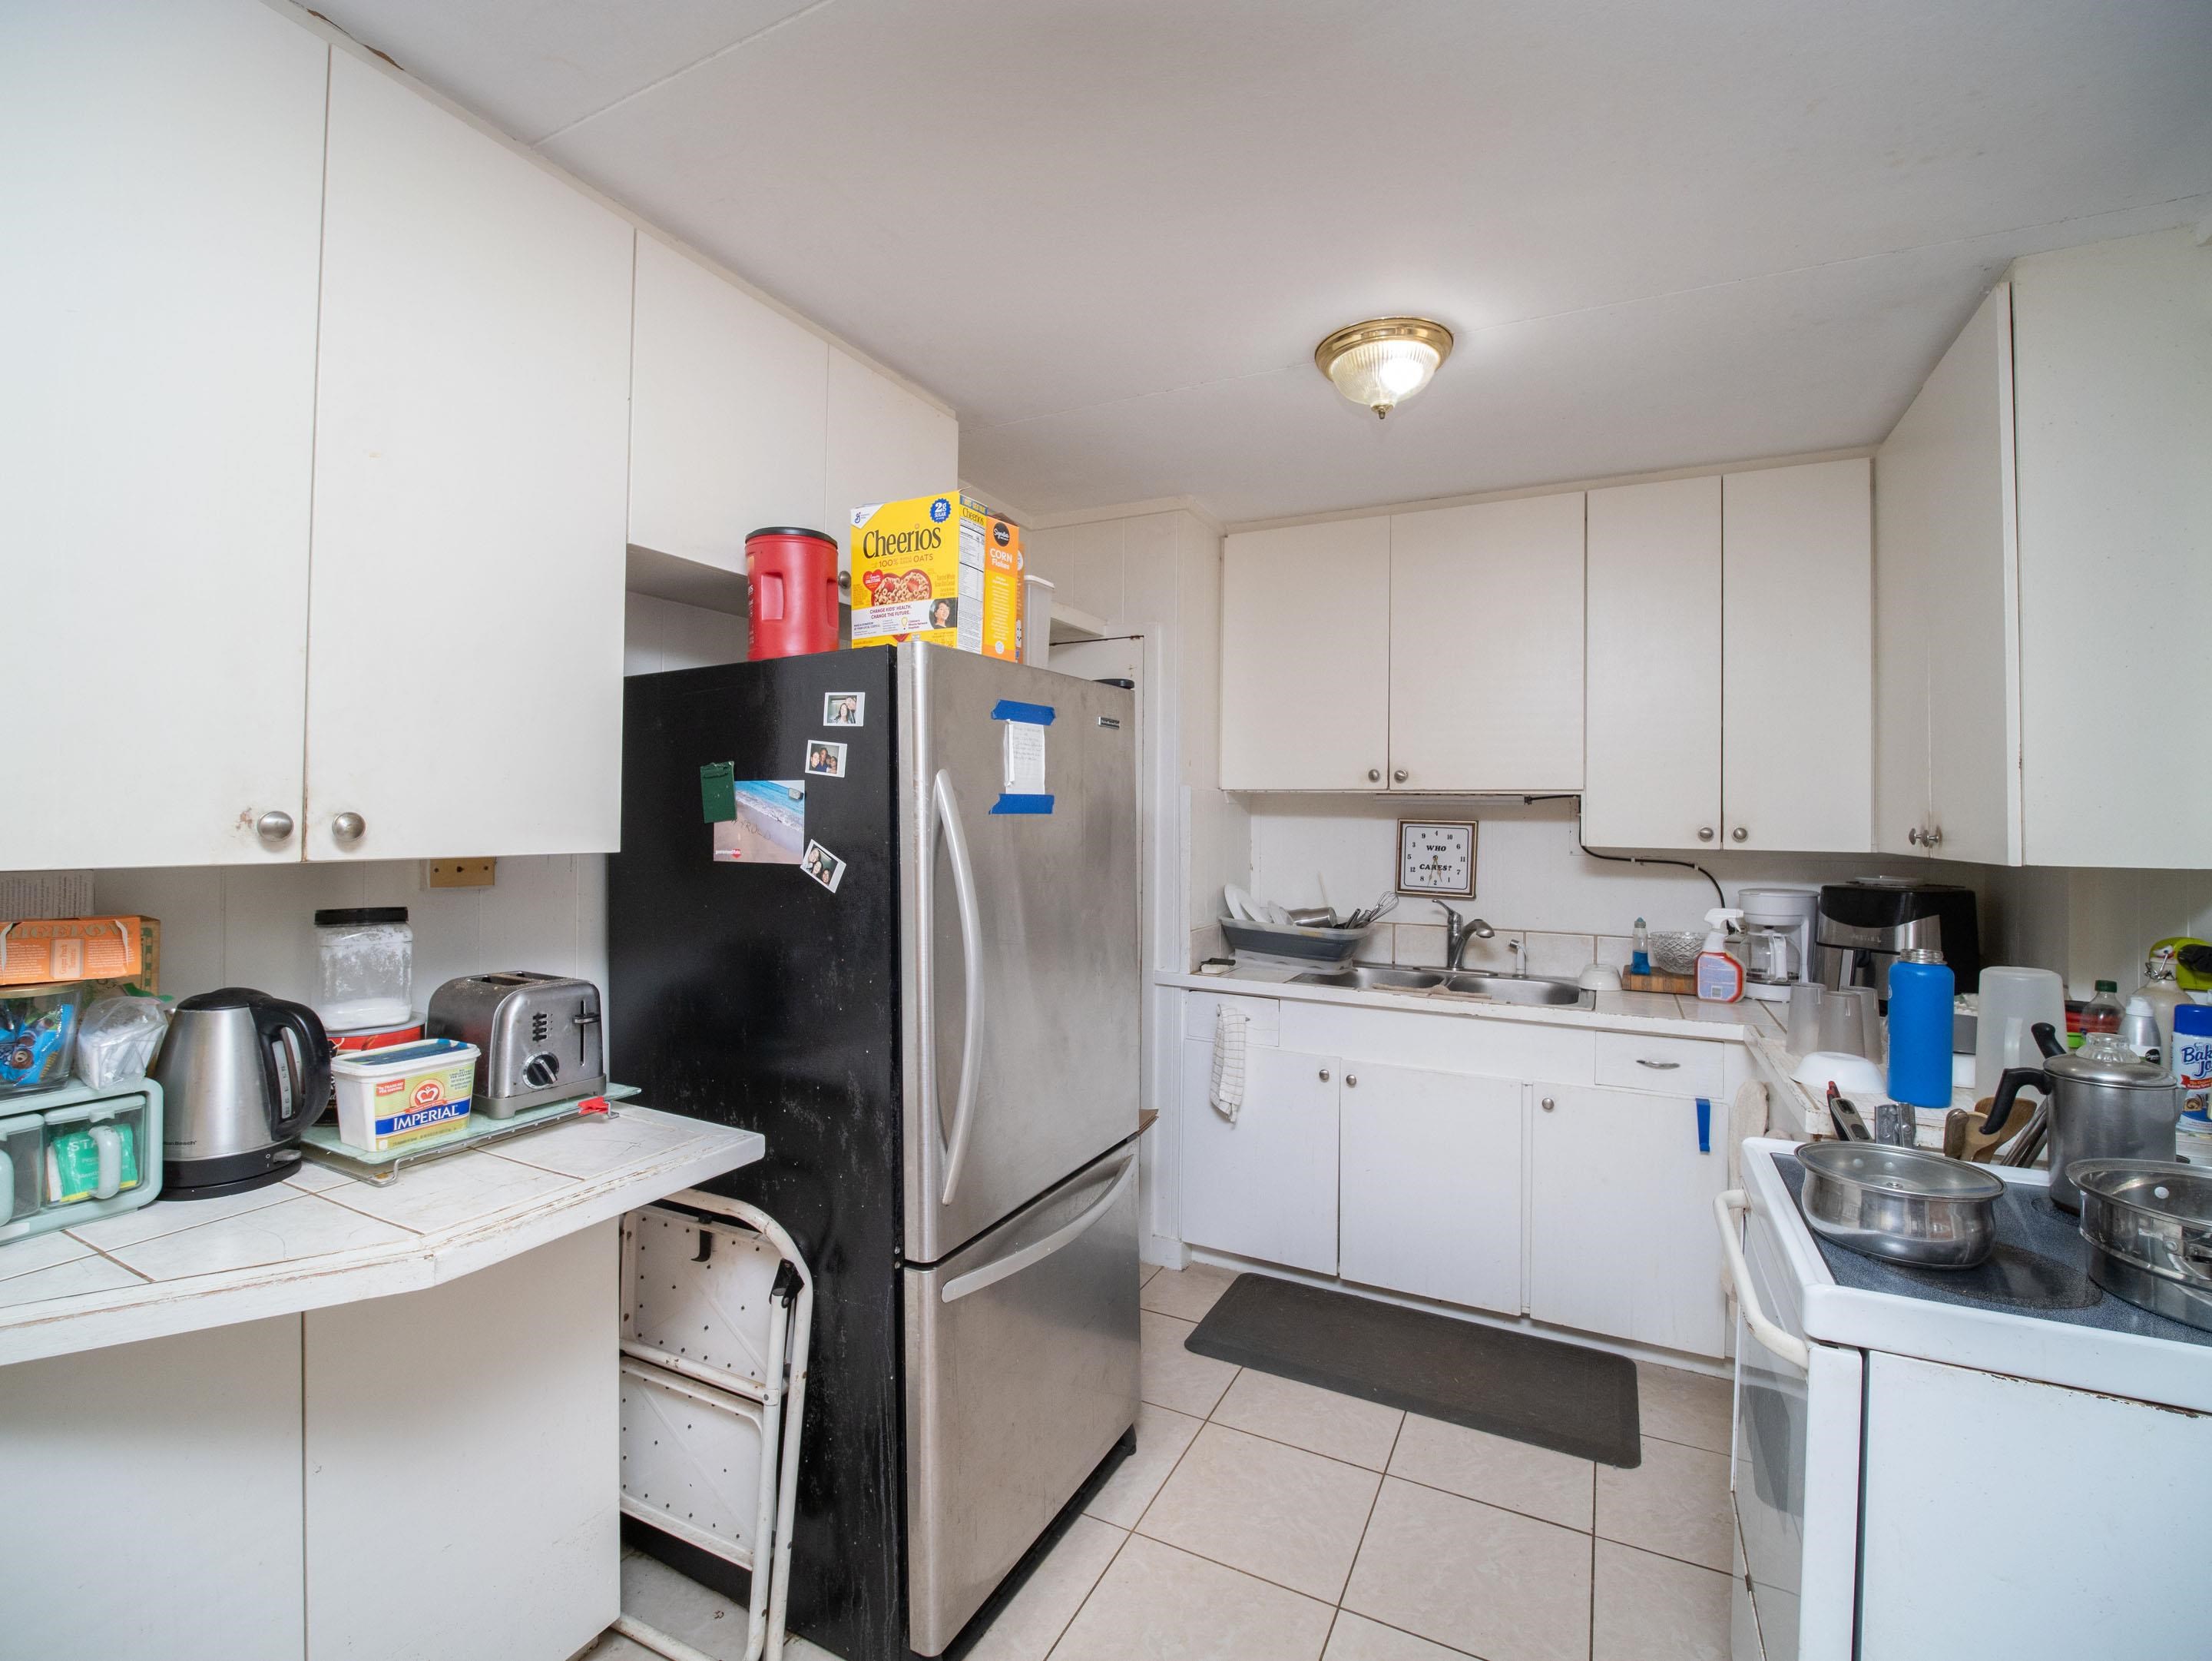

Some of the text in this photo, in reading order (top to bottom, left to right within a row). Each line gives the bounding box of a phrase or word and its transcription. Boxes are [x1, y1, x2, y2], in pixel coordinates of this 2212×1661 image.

[935, 502, 947, 513] 2g
[962, 507, 984, 525] Cheerios
[863, 523, 942, 559] Cheerios
[913, 553, 934, 562] OATS
[989, 548, 1012, 563] CORN
[992, 558, 1010, 569] Flakes
[392, 1105, 460, 1131] IMPERIAL
